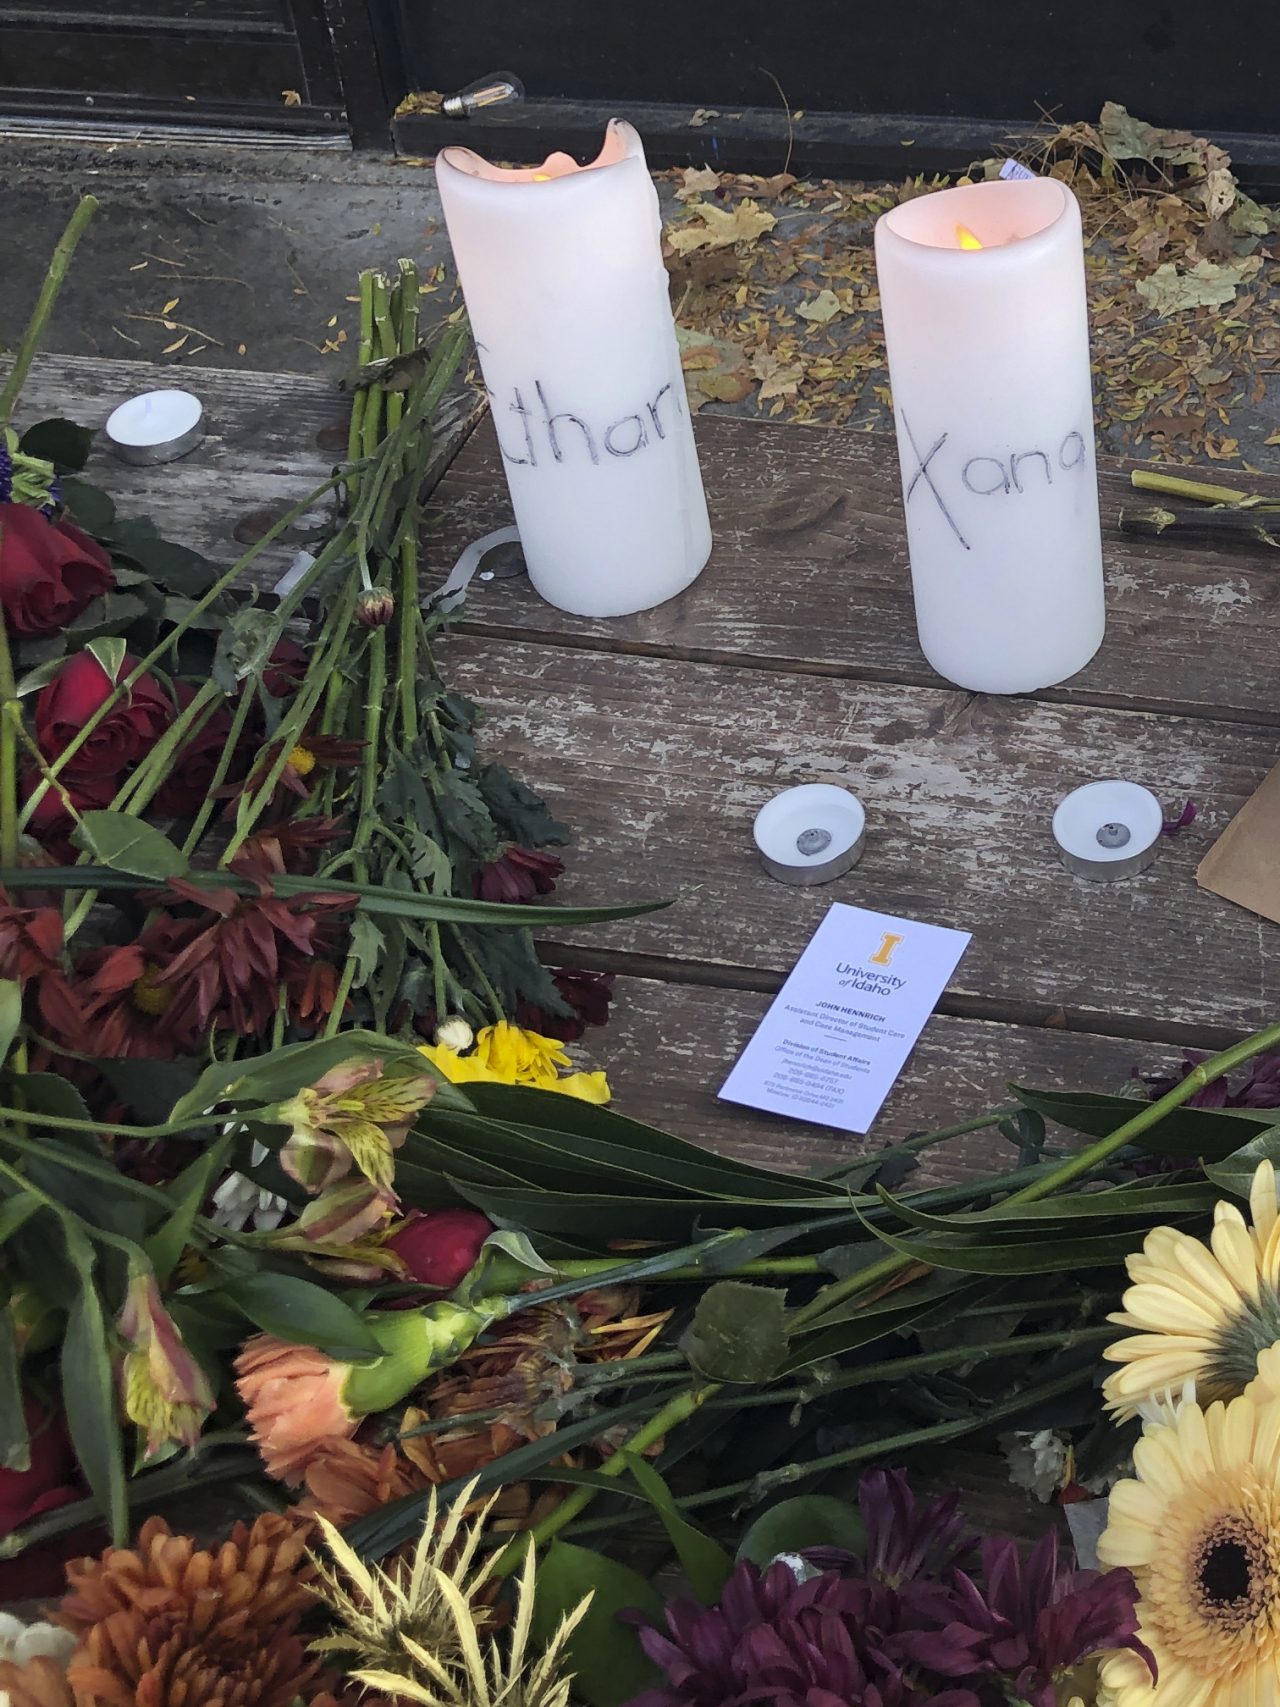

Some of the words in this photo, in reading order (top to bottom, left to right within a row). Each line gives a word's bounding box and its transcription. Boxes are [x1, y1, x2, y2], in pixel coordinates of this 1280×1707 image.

[901, 407, 1086, 551] Xana
[835, 961, 907, 991] University
[838, 976, 853, 988] of
[851, 977, 891, 996] Idaho
[784, 1004, 819, 1018] Assistant
[819, 1012, 849, 1026] Director
[848, 1019, 859, 1028] of
[856, 1022, 887, 1035] Student
[887, 1029, 905, 1039] Care
[815, 1000, 840, 1011] JOHN
[840, 1006, 886, 1023] HENNRICH
[799, 1017, 815, 1026] and
[814, 1020, 833, 1031] Case
[833, 1025, 881, 1043] Management
[782, 1039, 812, 1051] Division
[819, 1048, 847, 1060] Student
[847, 1055, 871, 1066] Affairs
[794, 1050, 804, 1058] of
[814, 1055, 832, 1065] Dean
[840, 1061, 871, 1074] Students
